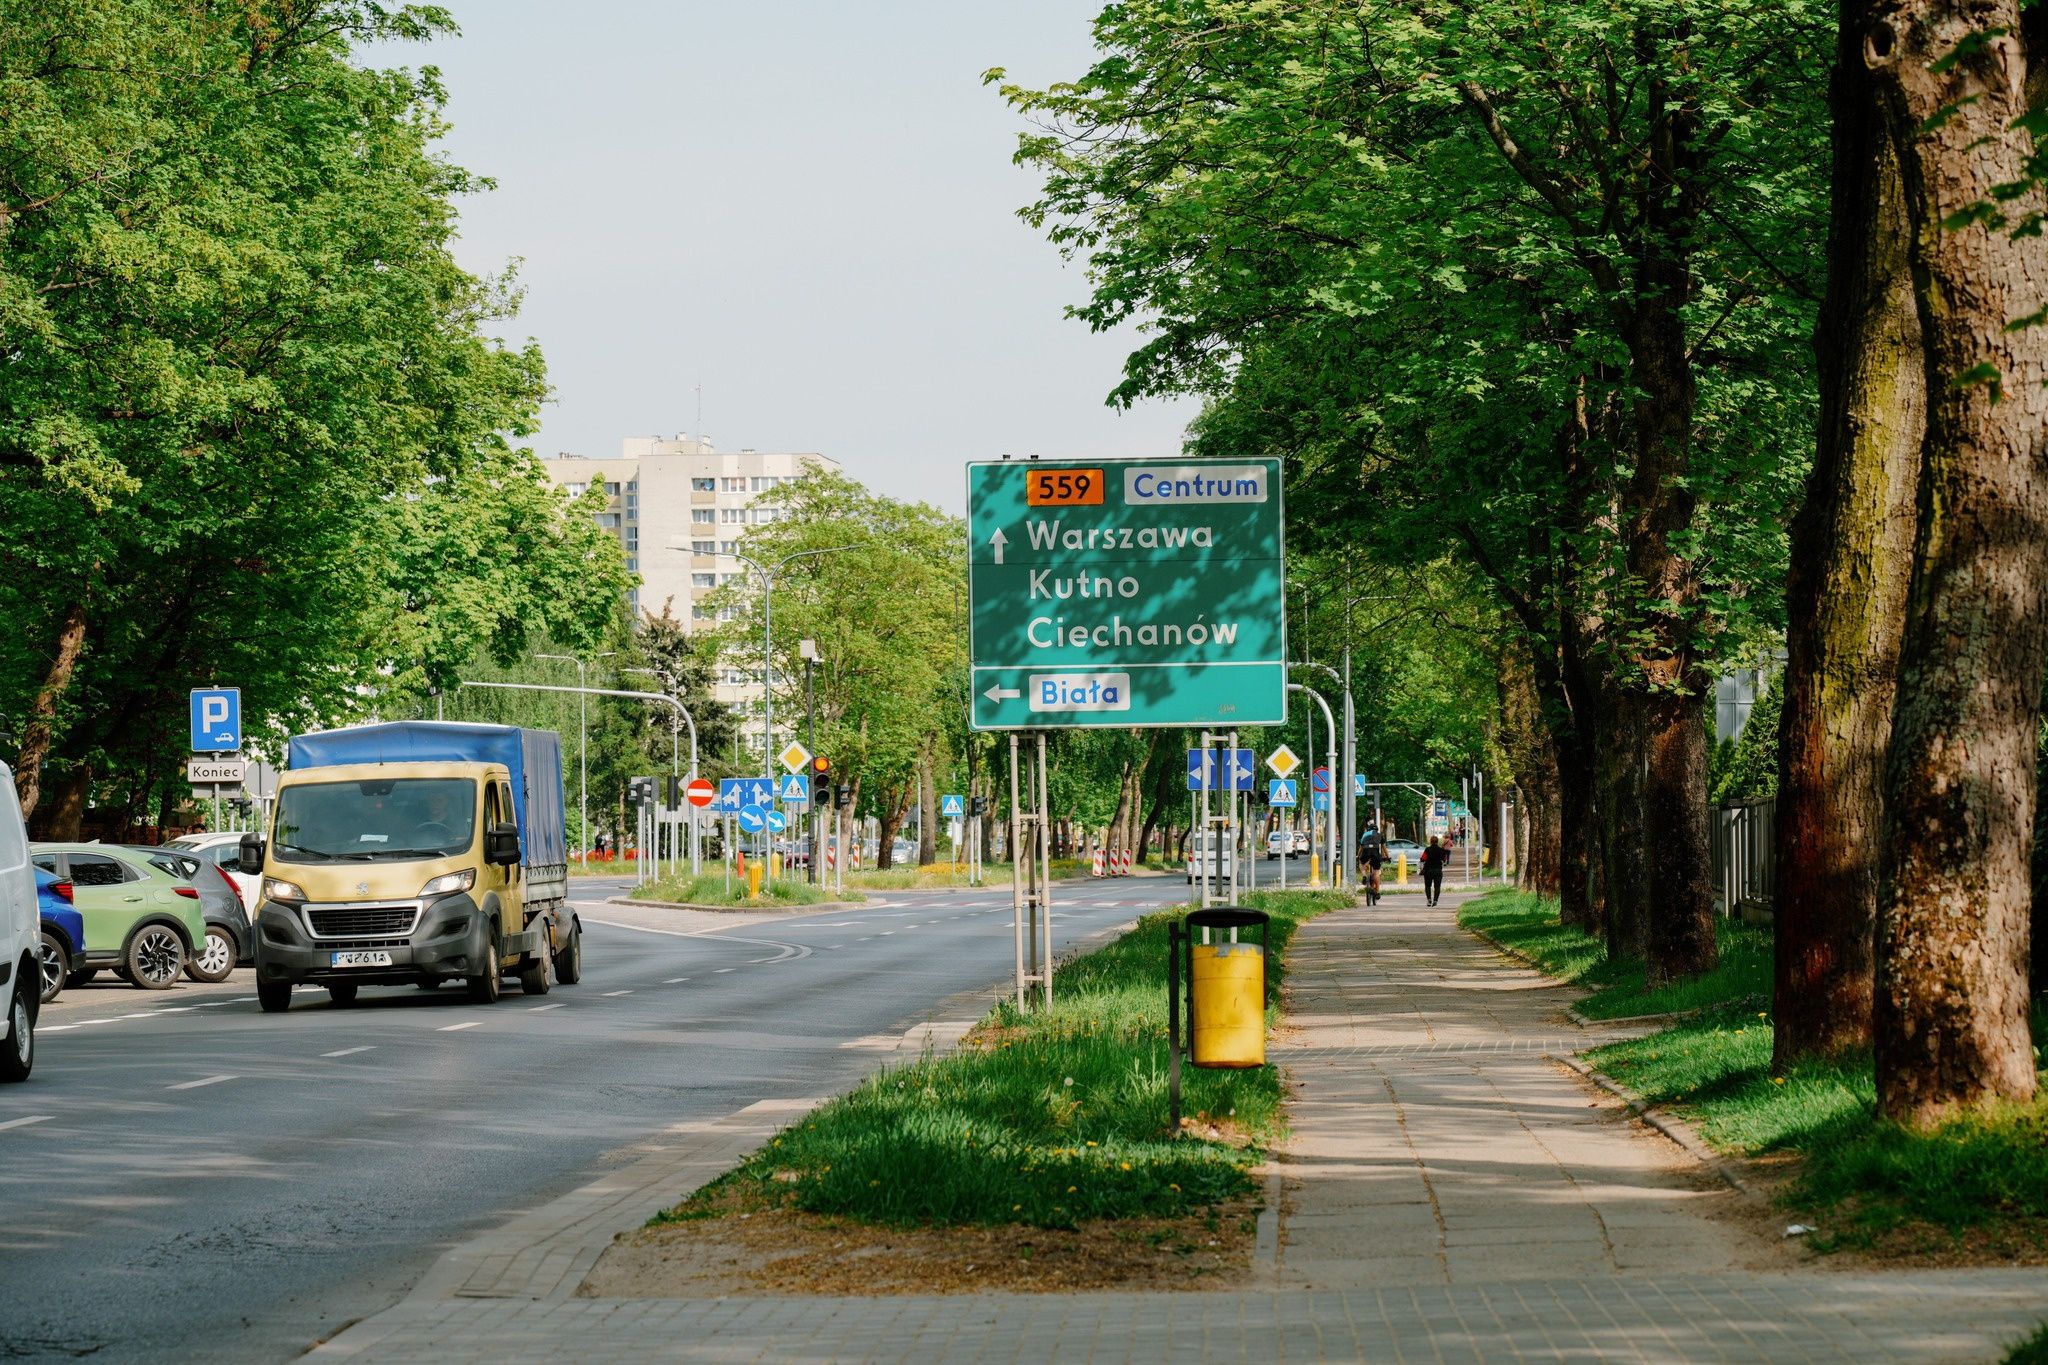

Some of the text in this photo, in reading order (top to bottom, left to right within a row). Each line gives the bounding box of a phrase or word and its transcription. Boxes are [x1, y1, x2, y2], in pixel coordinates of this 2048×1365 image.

[1039, 475, 1091, 500] 559
[1134, 473, 1258, 498] Centrum
[1026, 520, 1213, 551] Warszawa
[1029, 568, 1140, 600] Kutno
[1027, 614, 1238, 649] Ciechanów
[1041, 680, 1119, 705] Biała
[202, 696, 229, 733] P
[193, 766, 238, 777] Koniec
